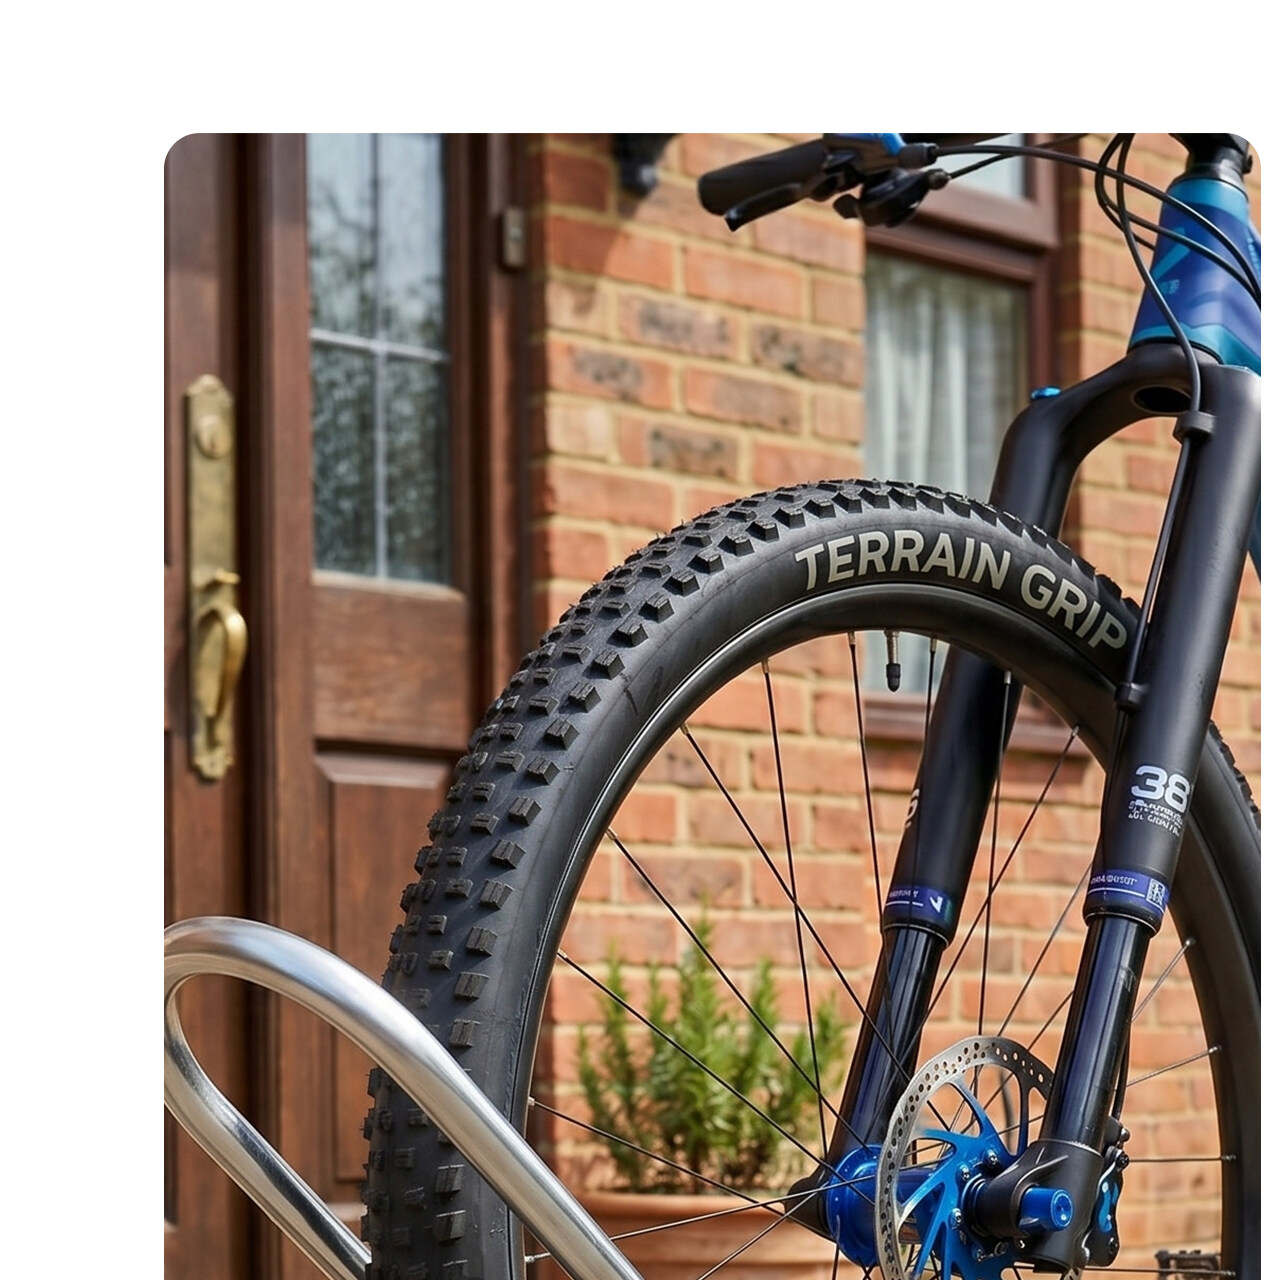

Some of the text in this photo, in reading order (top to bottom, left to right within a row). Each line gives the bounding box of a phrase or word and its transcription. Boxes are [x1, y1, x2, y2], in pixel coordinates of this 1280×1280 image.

[795, 529, 1128, 651] TERRAIN GRIP
[1131, 765, 1191, 814] 38
